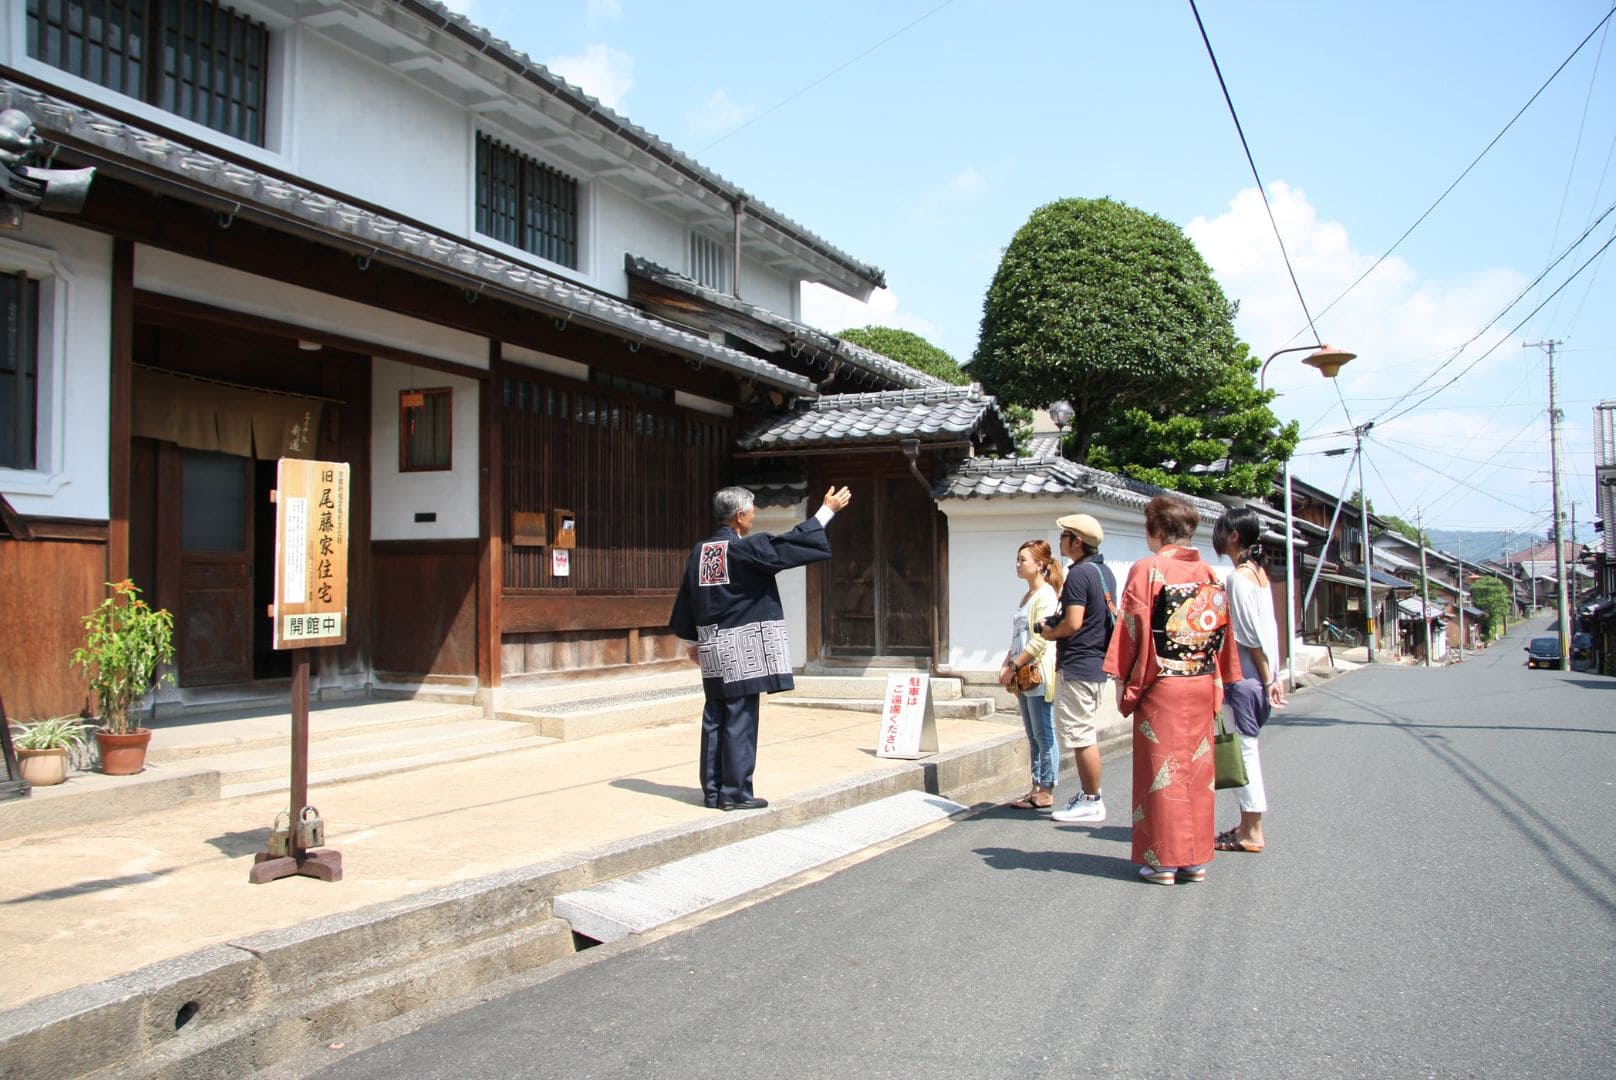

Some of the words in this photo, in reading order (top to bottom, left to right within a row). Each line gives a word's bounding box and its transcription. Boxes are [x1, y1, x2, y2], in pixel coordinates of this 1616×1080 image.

[317, 469, 335, 604] 旧尾藤家住宅
[290, 615, 336, 636] 開館中
[907, 677, 920, 705] 駐車は
[884, 684, 904, 752] ご遠慮ください
